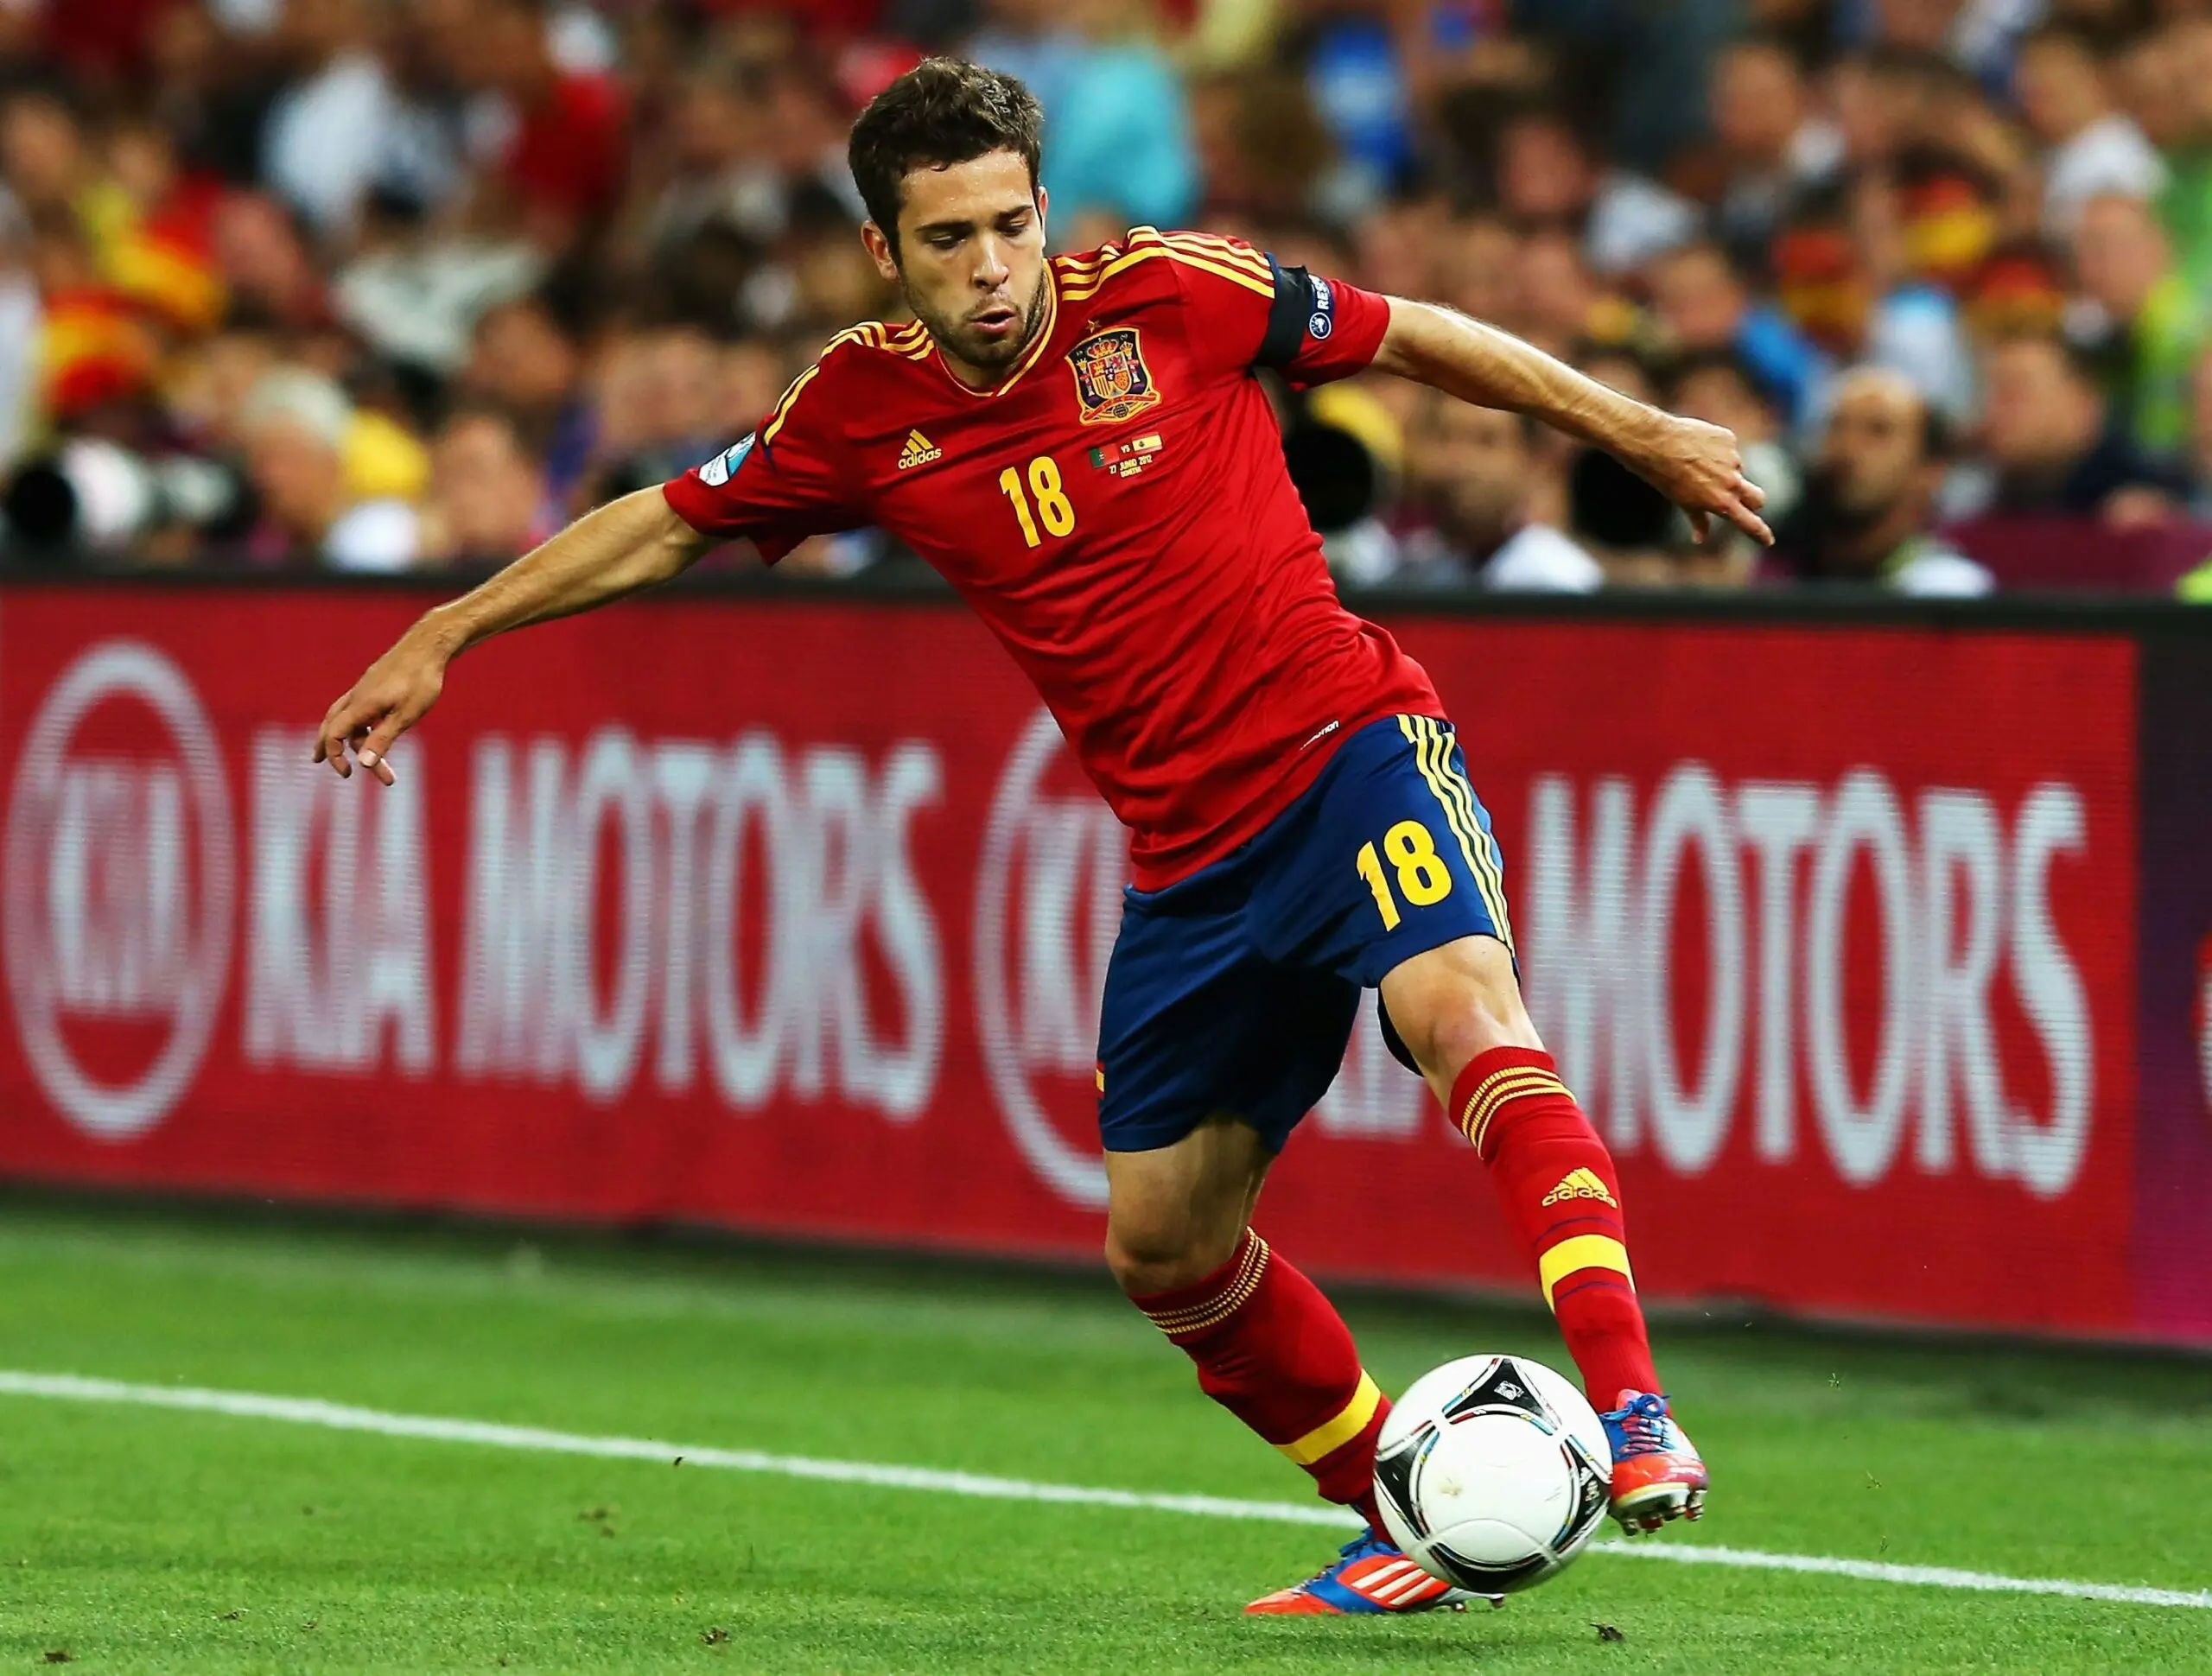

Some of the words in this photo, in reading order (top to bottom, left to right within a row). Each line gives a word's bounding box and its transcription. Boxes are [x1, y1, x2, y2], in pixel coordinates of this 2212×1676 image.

[898, 448, 942, 469] adidas
[999, 456, 1075, 548] 18
[1139, 454, 1153, 466] 2012
[1357, 819, 1452, 932] 18
[246, 724, 434, 1082] KIA
[458, 726, 944, 1125] MOTORS
[1526, 759, 2094, 1202] MOTORS
[1541, 1187, 1618, 1209] adidas
